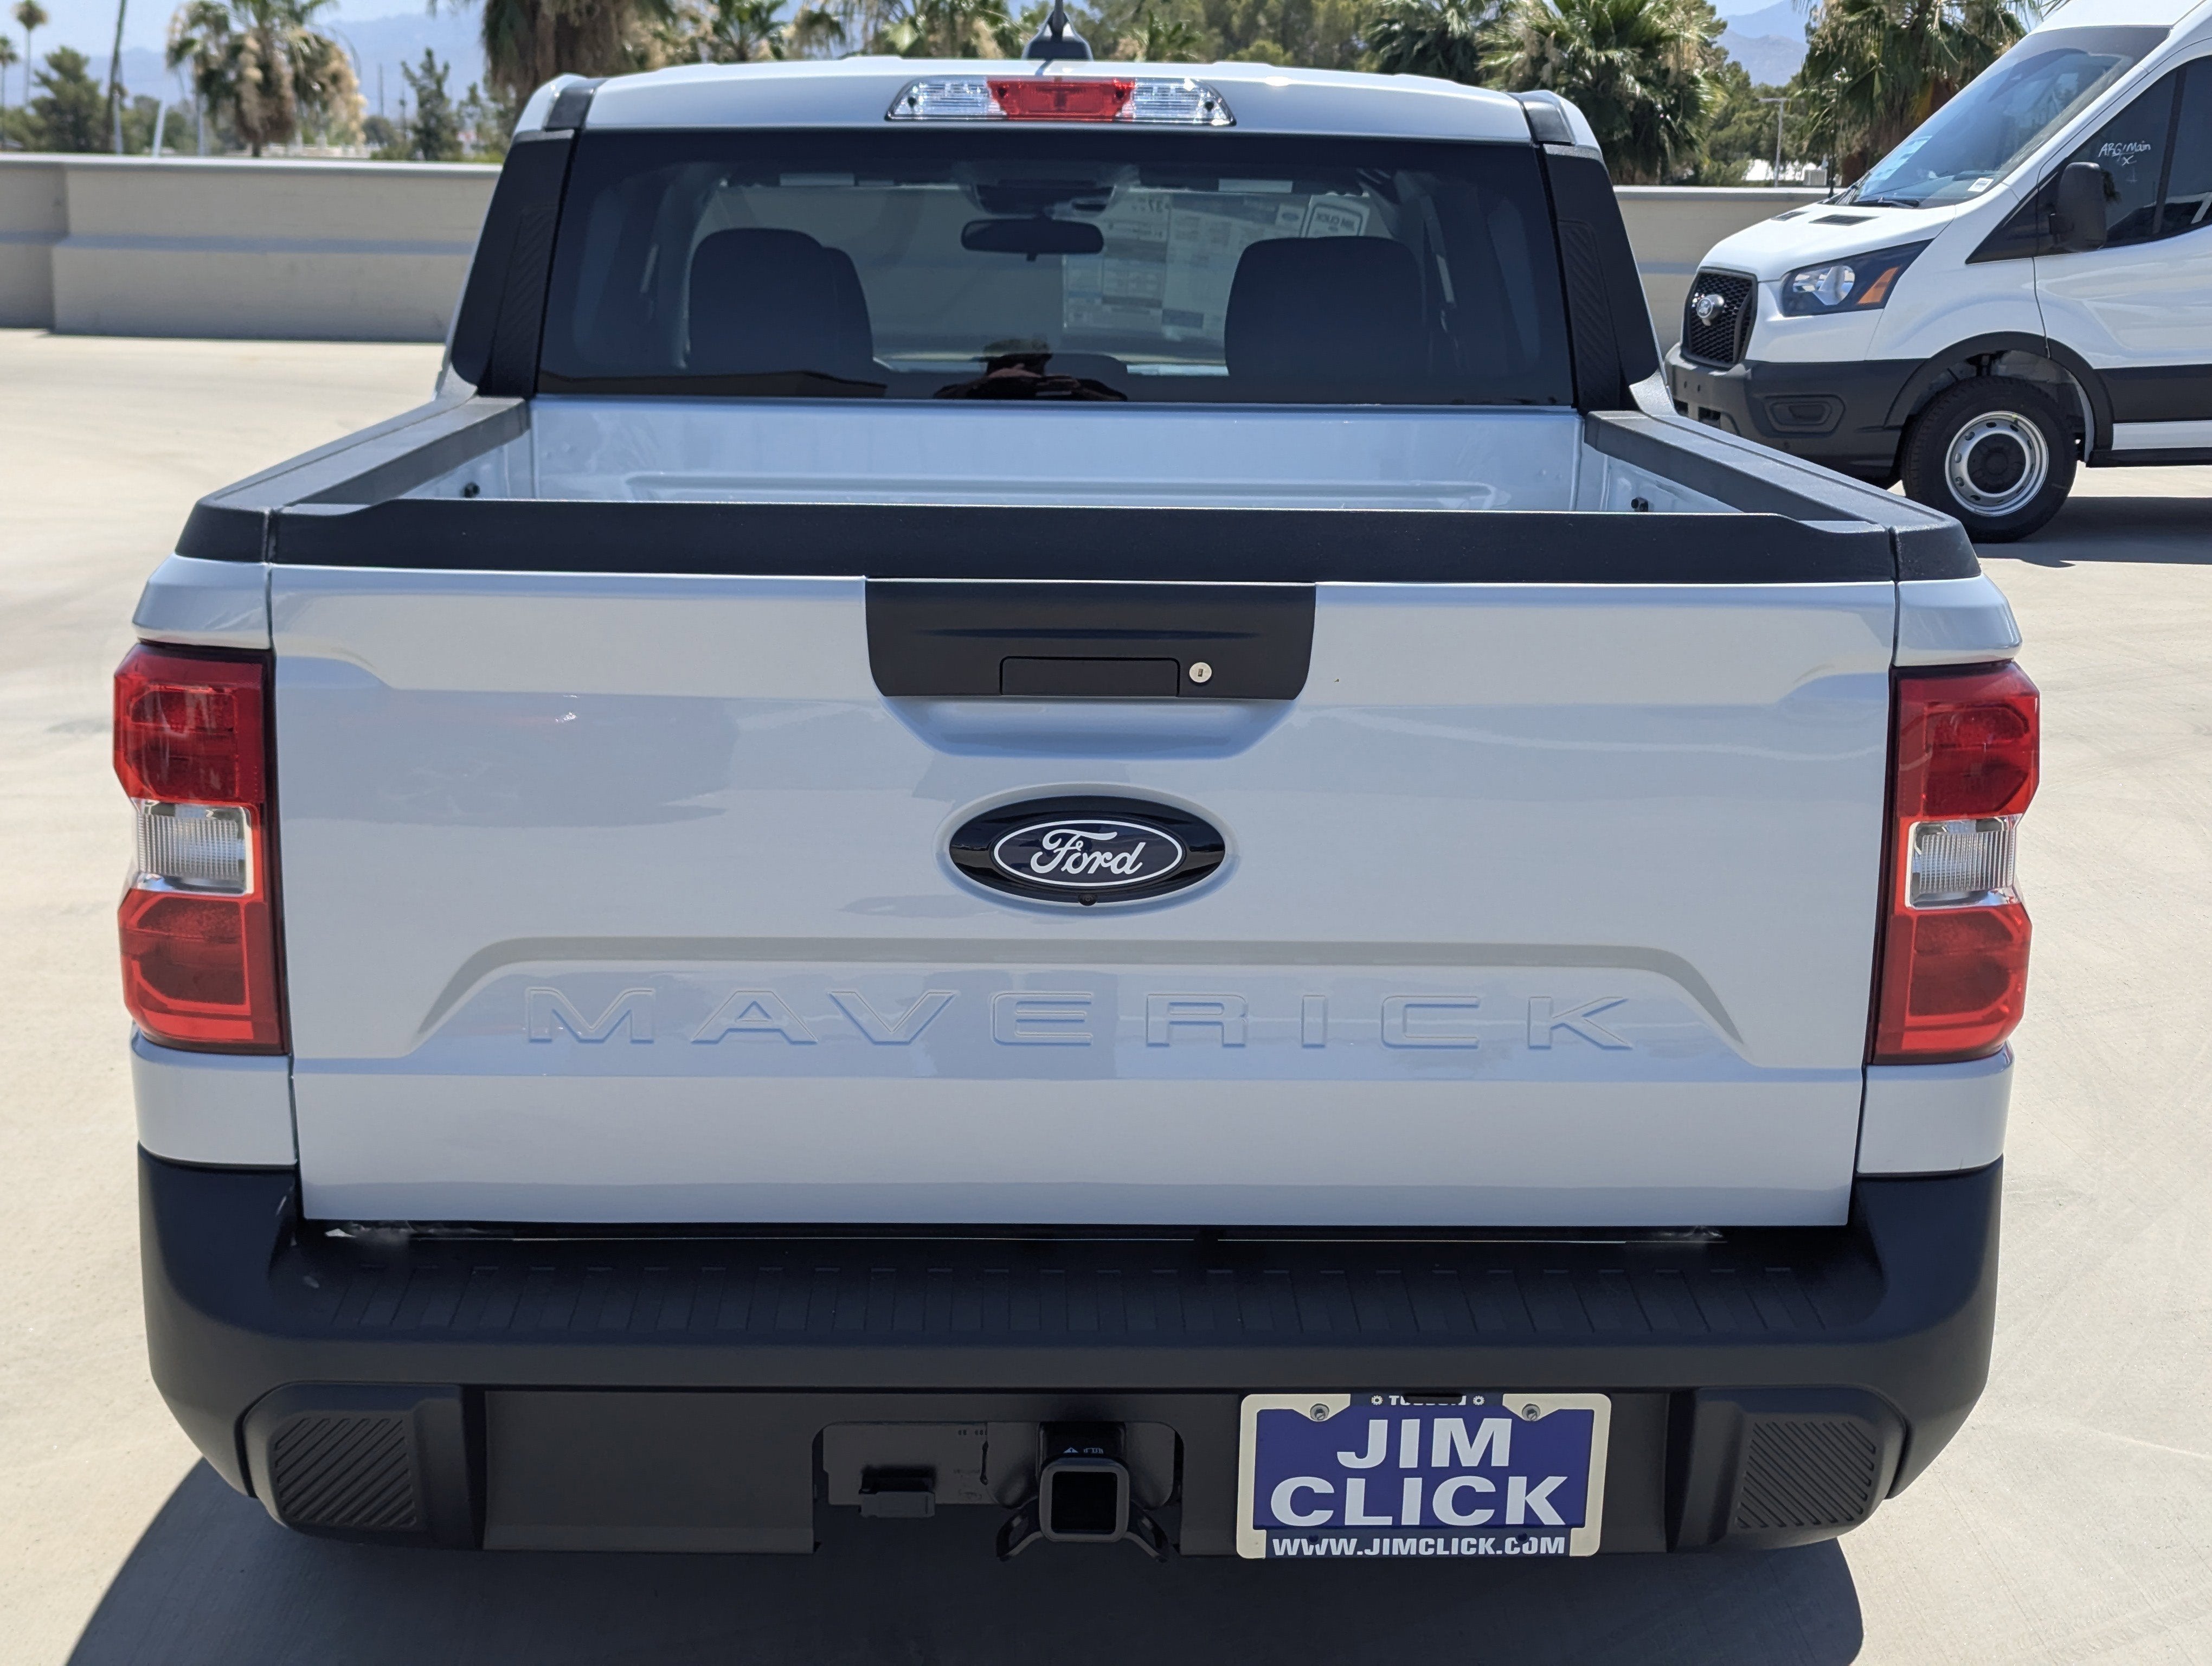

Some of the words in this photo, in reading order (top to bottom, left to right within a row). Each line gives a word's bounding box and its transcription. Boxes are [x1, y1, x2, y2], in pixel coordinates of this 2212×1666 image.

[1030, 828, 1147, 875] Ford
[525, 987, 1633, 1050] MAVERICK
[1336, 1417, 1513, 1469] JIM
[1270, 1475, 1568, 1527] CLICK
[1272, 1536, 1566, 1557] WWW.JIMCLICK.COM
